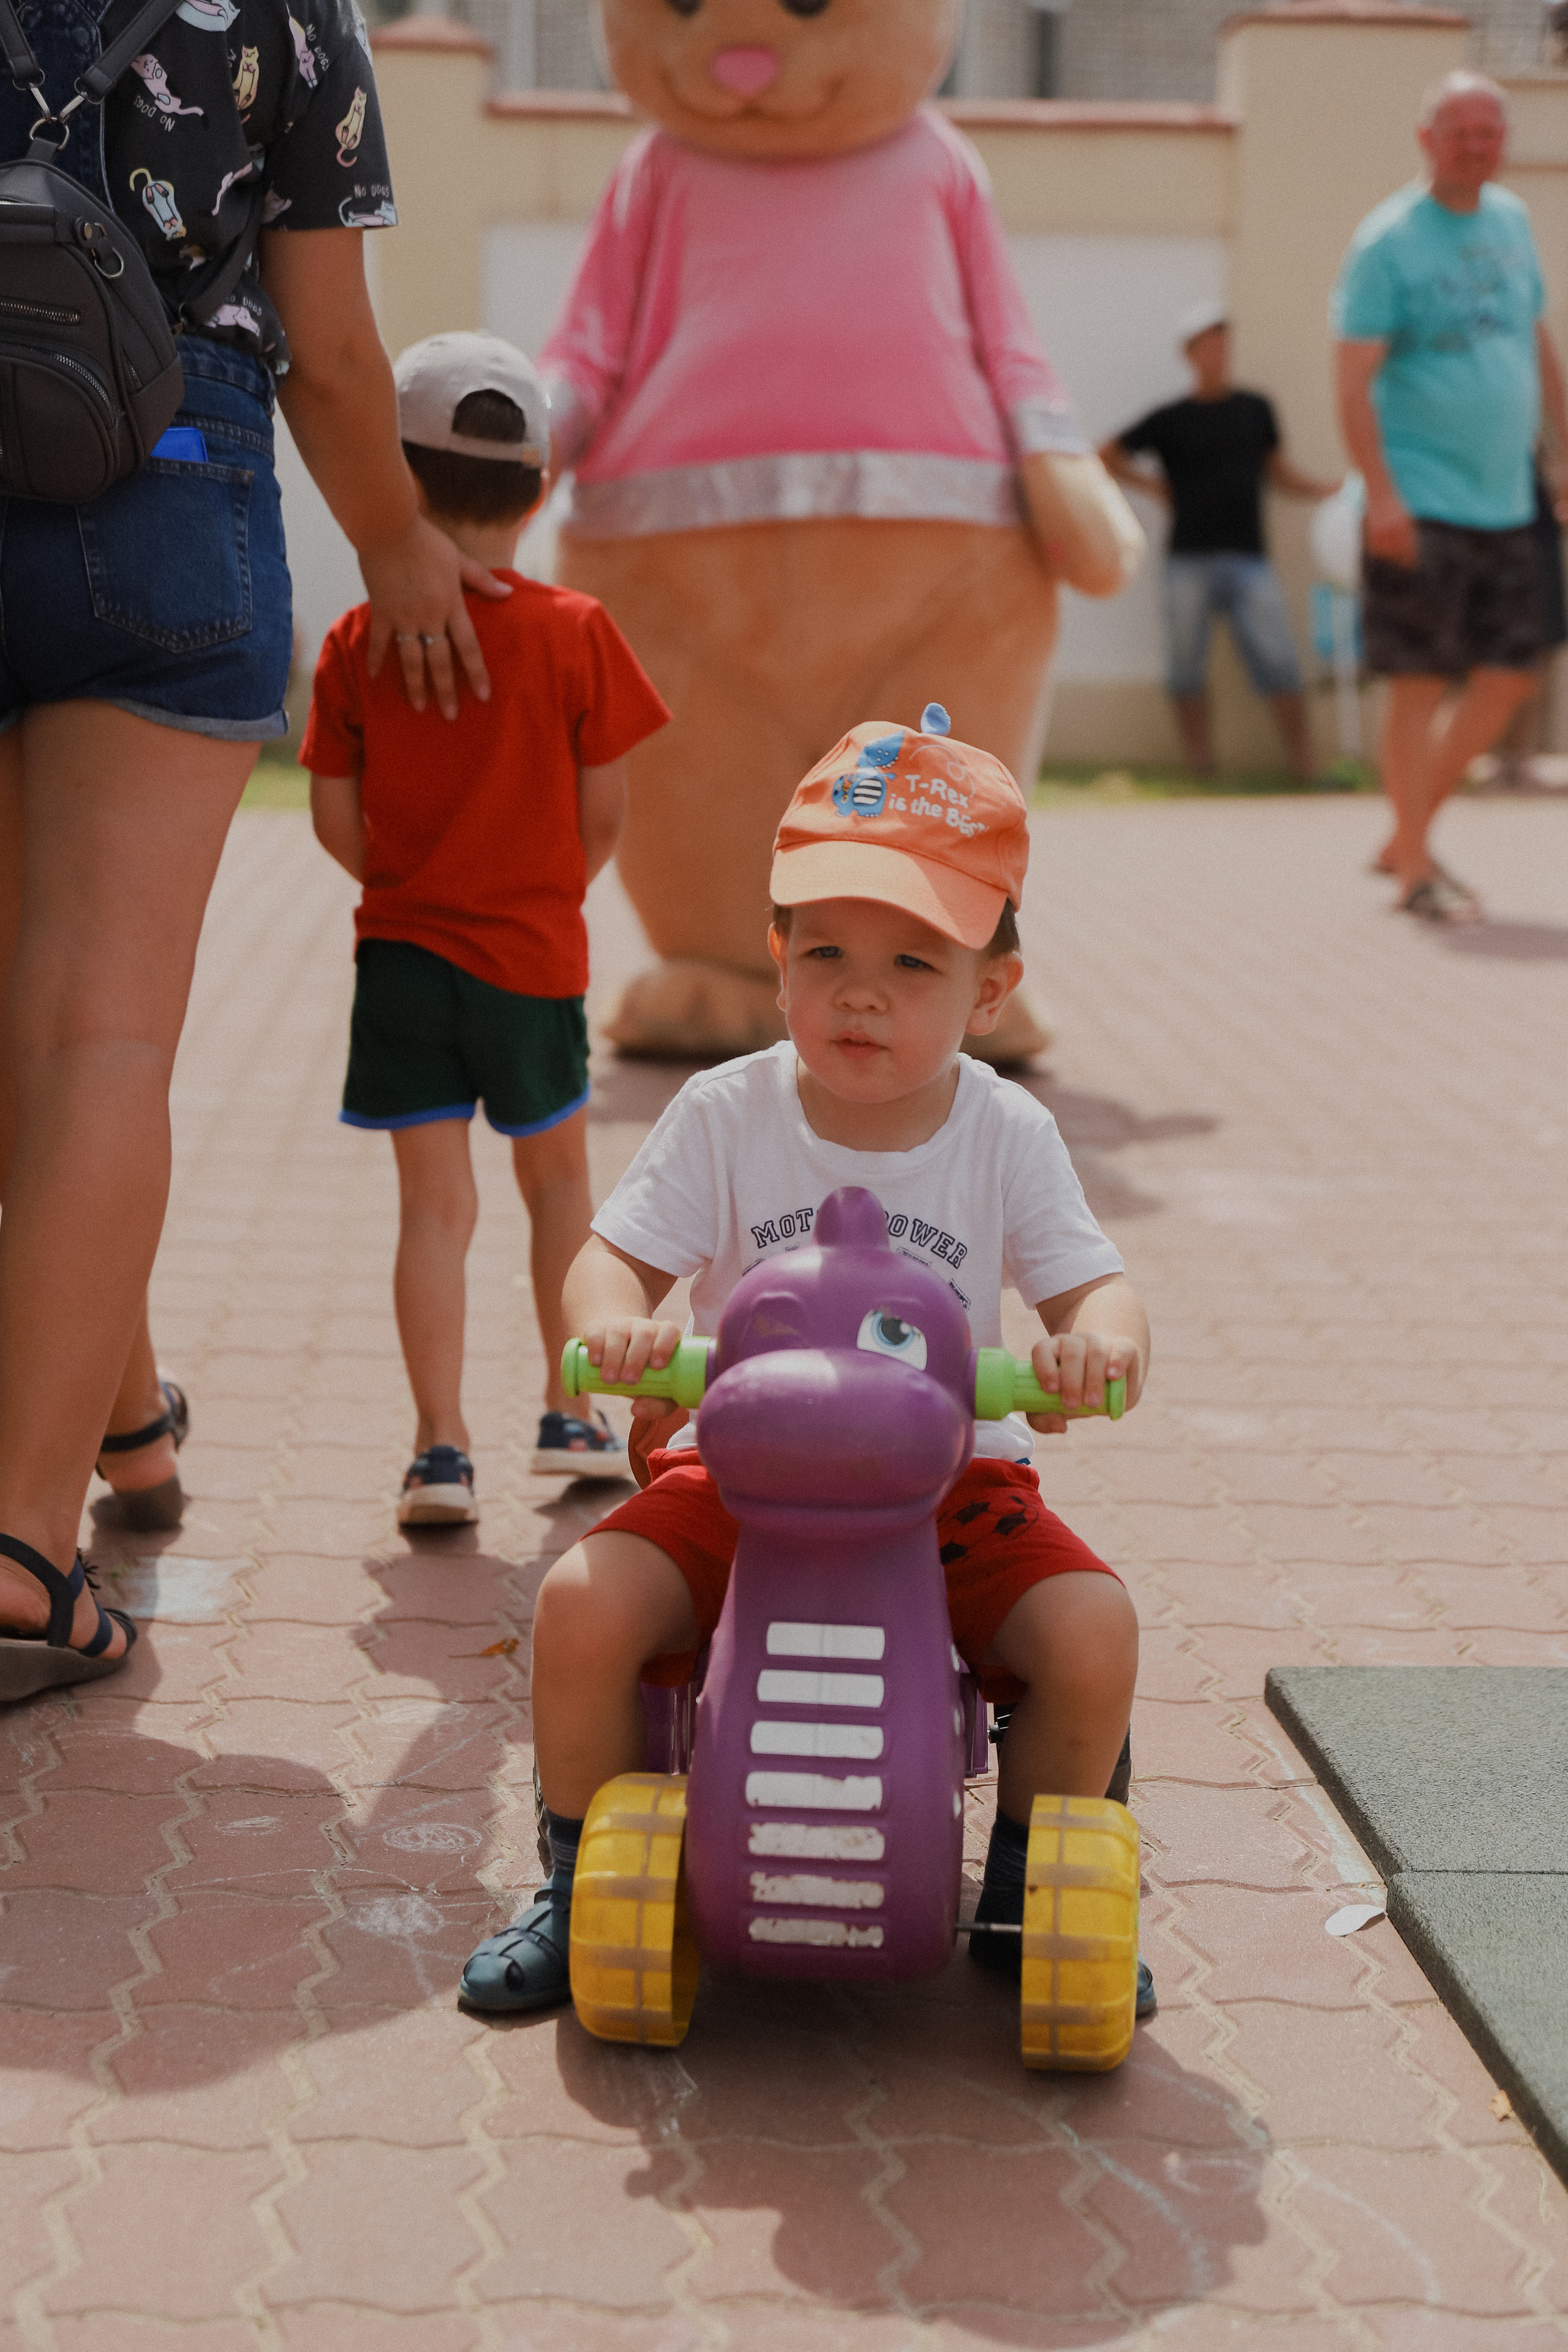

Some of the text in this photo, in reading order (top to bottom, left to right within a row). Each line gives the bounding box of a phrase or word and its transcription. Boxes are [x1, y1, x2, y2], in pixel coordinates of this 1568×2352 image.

[888, 793, 907, 812] is
[910, 796, 943, 818] the
[905, 774, 969, 809] T-Rex
[750, 1207, 968, 1269] MOT OWER
